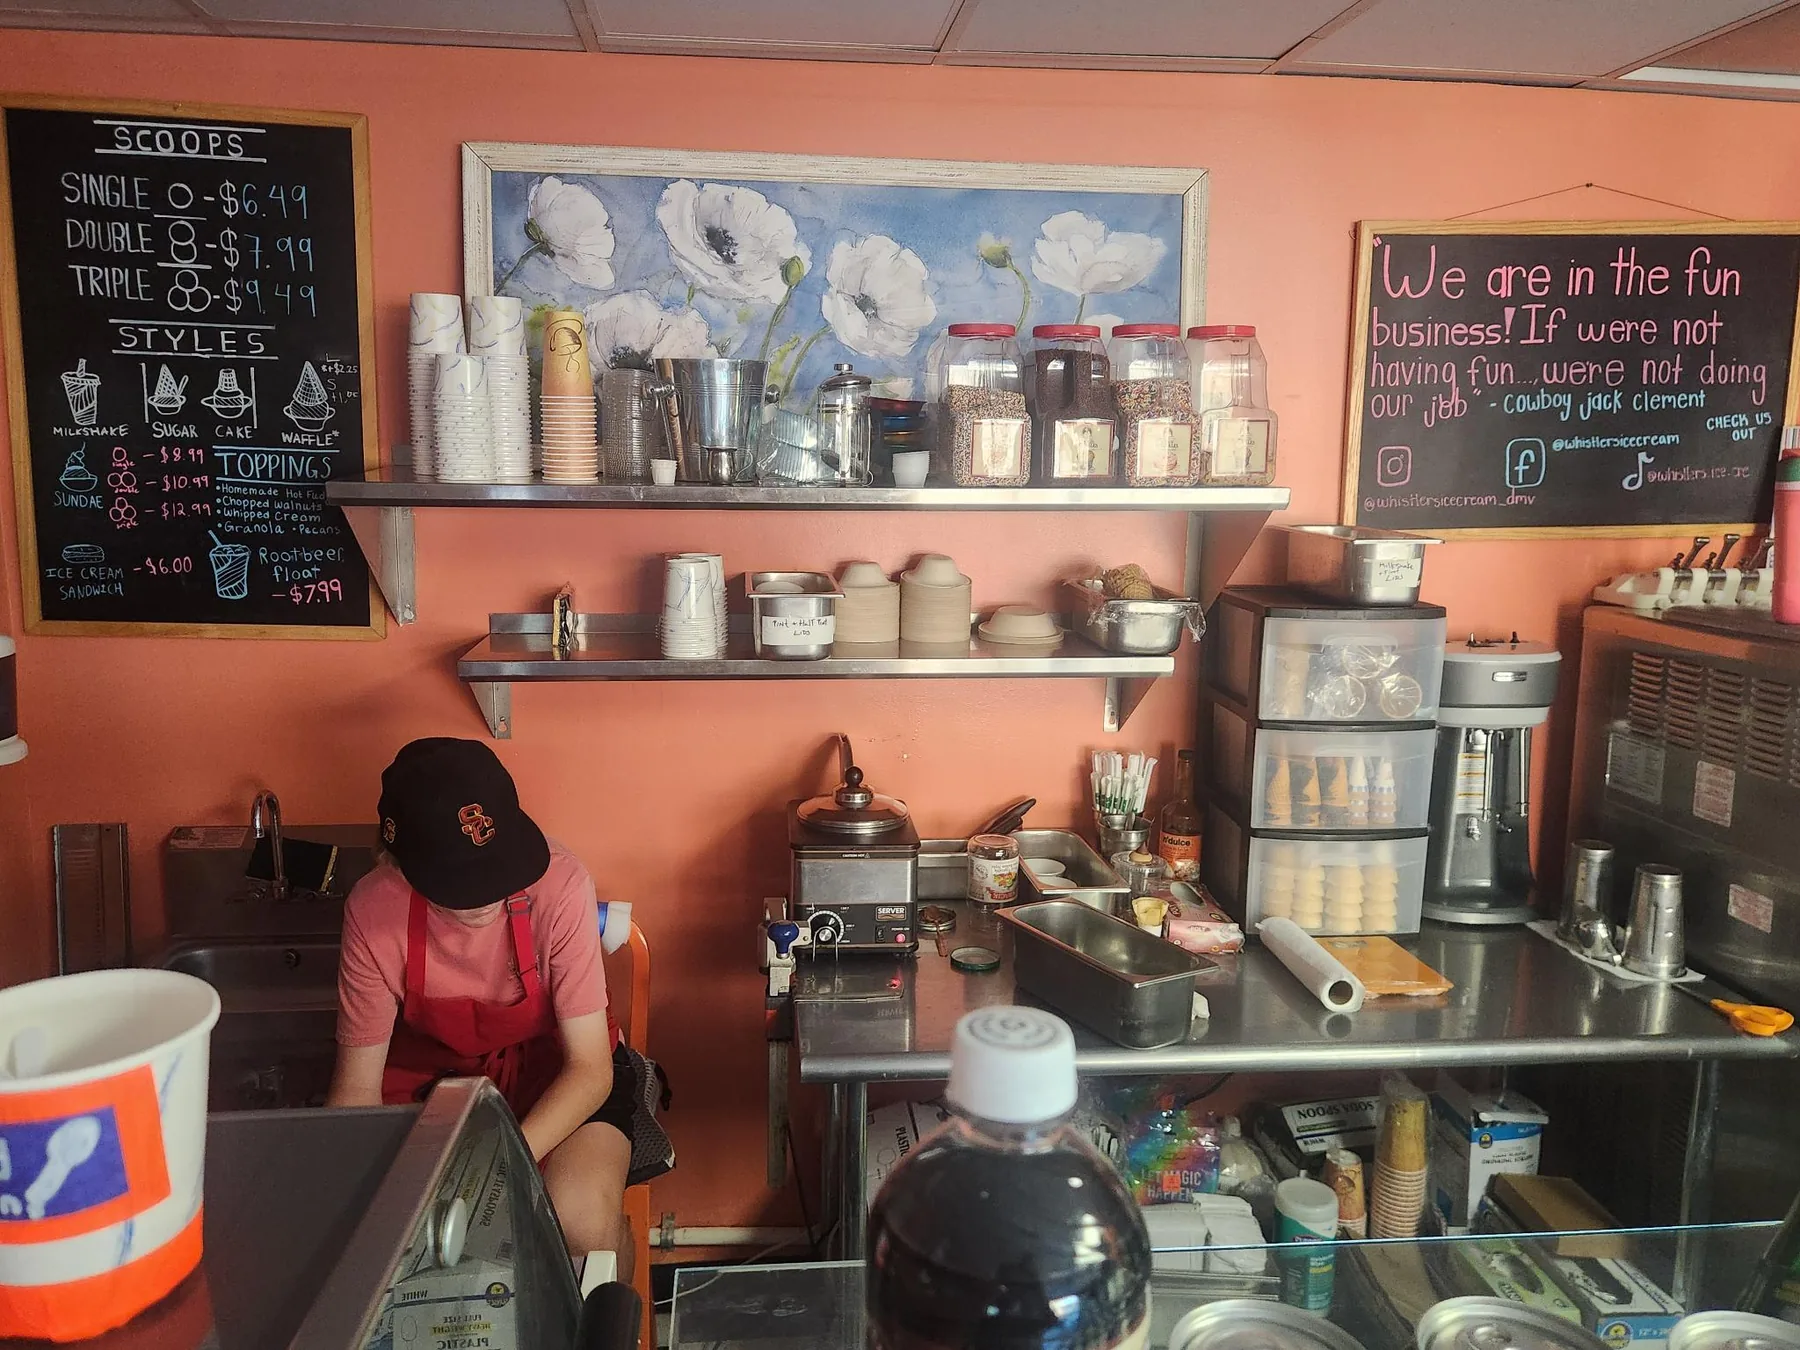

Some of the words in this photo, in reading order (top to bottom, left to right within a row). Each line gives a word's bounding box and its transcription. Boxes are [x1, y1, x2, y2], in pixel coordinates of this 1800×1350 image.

[114, 126, 245, 158] SCOOPS
[60, 172, 152, 211] SINGLE
[65, 219, 155, 254] DOUBLE
[1487, 264, 1551, 298] are
[1567, 259, 1595, 296] in
[1609, 247, 1670, 296] the
[1685, 246, 1741, 297] fun
[68, 264, 154, 302] TRIPLE
[1372, 306, 1516, 347] business!
[1519, 304, 1566, 345] If
[1673, 310, 1723, 345] not
[118, 326, 266, 354] STYLES
[1371, 351, 1458, 400] having
[1641, 354, 1683, 385] not
[1700, 350, 1768, 406] doing
[1371, 394, 1412, 419] our
[1579, 390, 1623, 420] jack
[1632, 389, 1706, 411] clement
[53, 424, 129, 437] MILKSHAKE
[152, 421, 199, 438] SUGAR
[1706, 413, 1749, 431] CHECK
[1755, 412, 1772, 425] US
[215, 425, 253, 440] CAKE
[1731, 427, 1757, 441] OUT
[214, 453, 331, 480] TOPPINGS
[54, 490, 104, 509] SUNDAE
[286, 488, 303, 499] Hot
[307, 490, 327, 500] Fud
[274, 511, 321, 523] Cream
[46, 567, 72, 579] ICE
[81, 566, 124, 580] CREAM
[272, 565, 322, 581] float
[59, 583, 124, 600] SANDWICH
